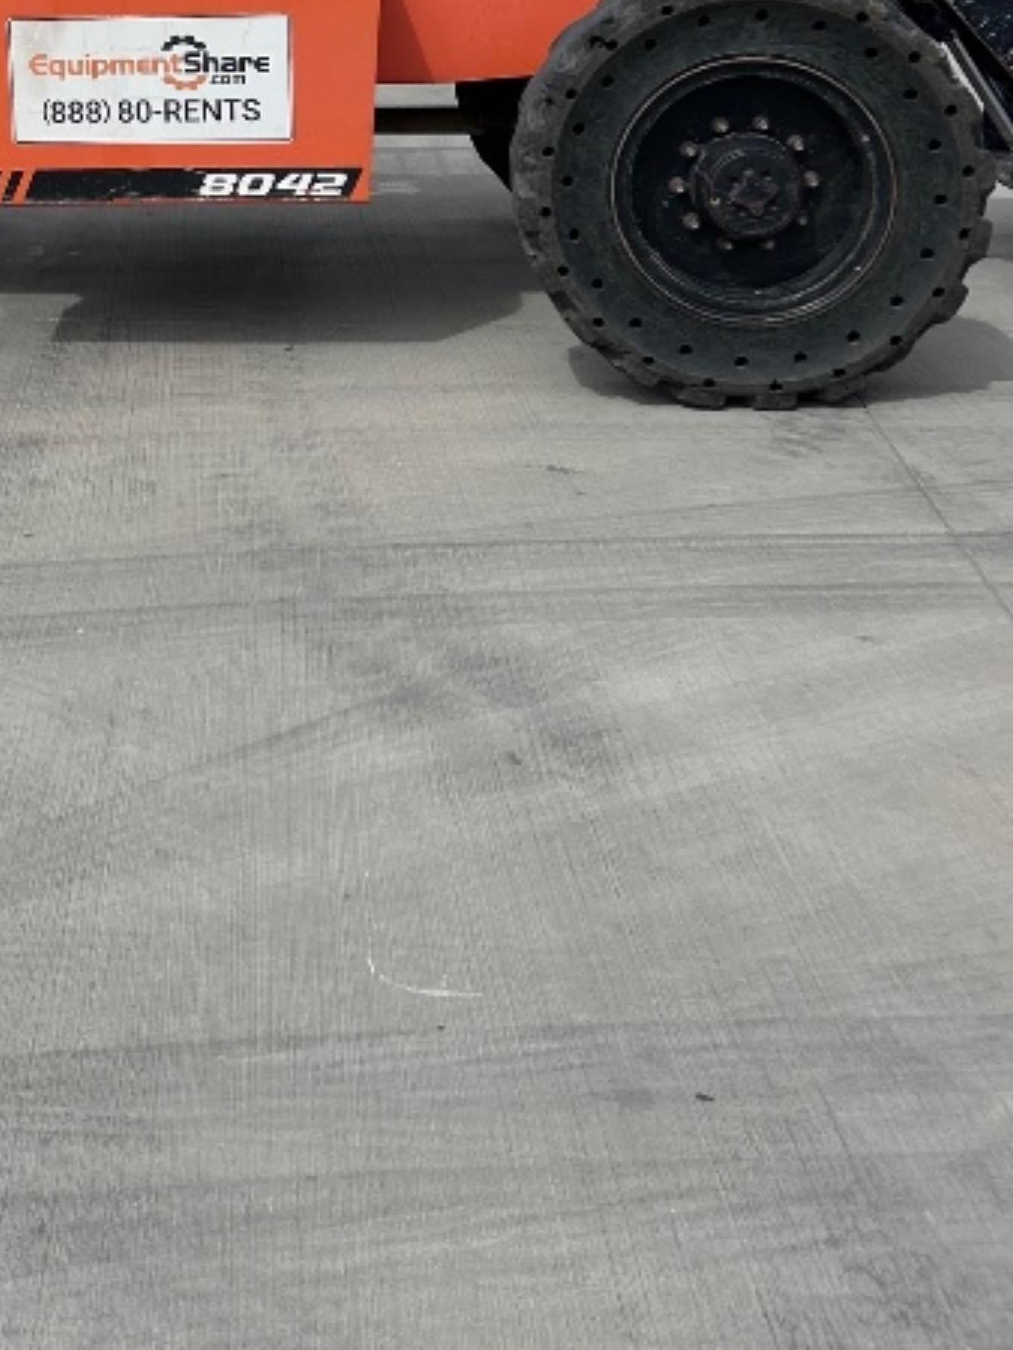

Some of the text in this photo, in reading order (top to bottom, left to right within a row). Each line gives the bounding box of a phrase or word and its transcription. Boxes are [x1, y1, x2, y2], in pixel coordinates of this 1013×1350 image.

[28, 50, 271, 81] EquipmentShare
[42, 98, 262, 125] (888) 80-RENTS
[198, 172, 349, 197] 8042
